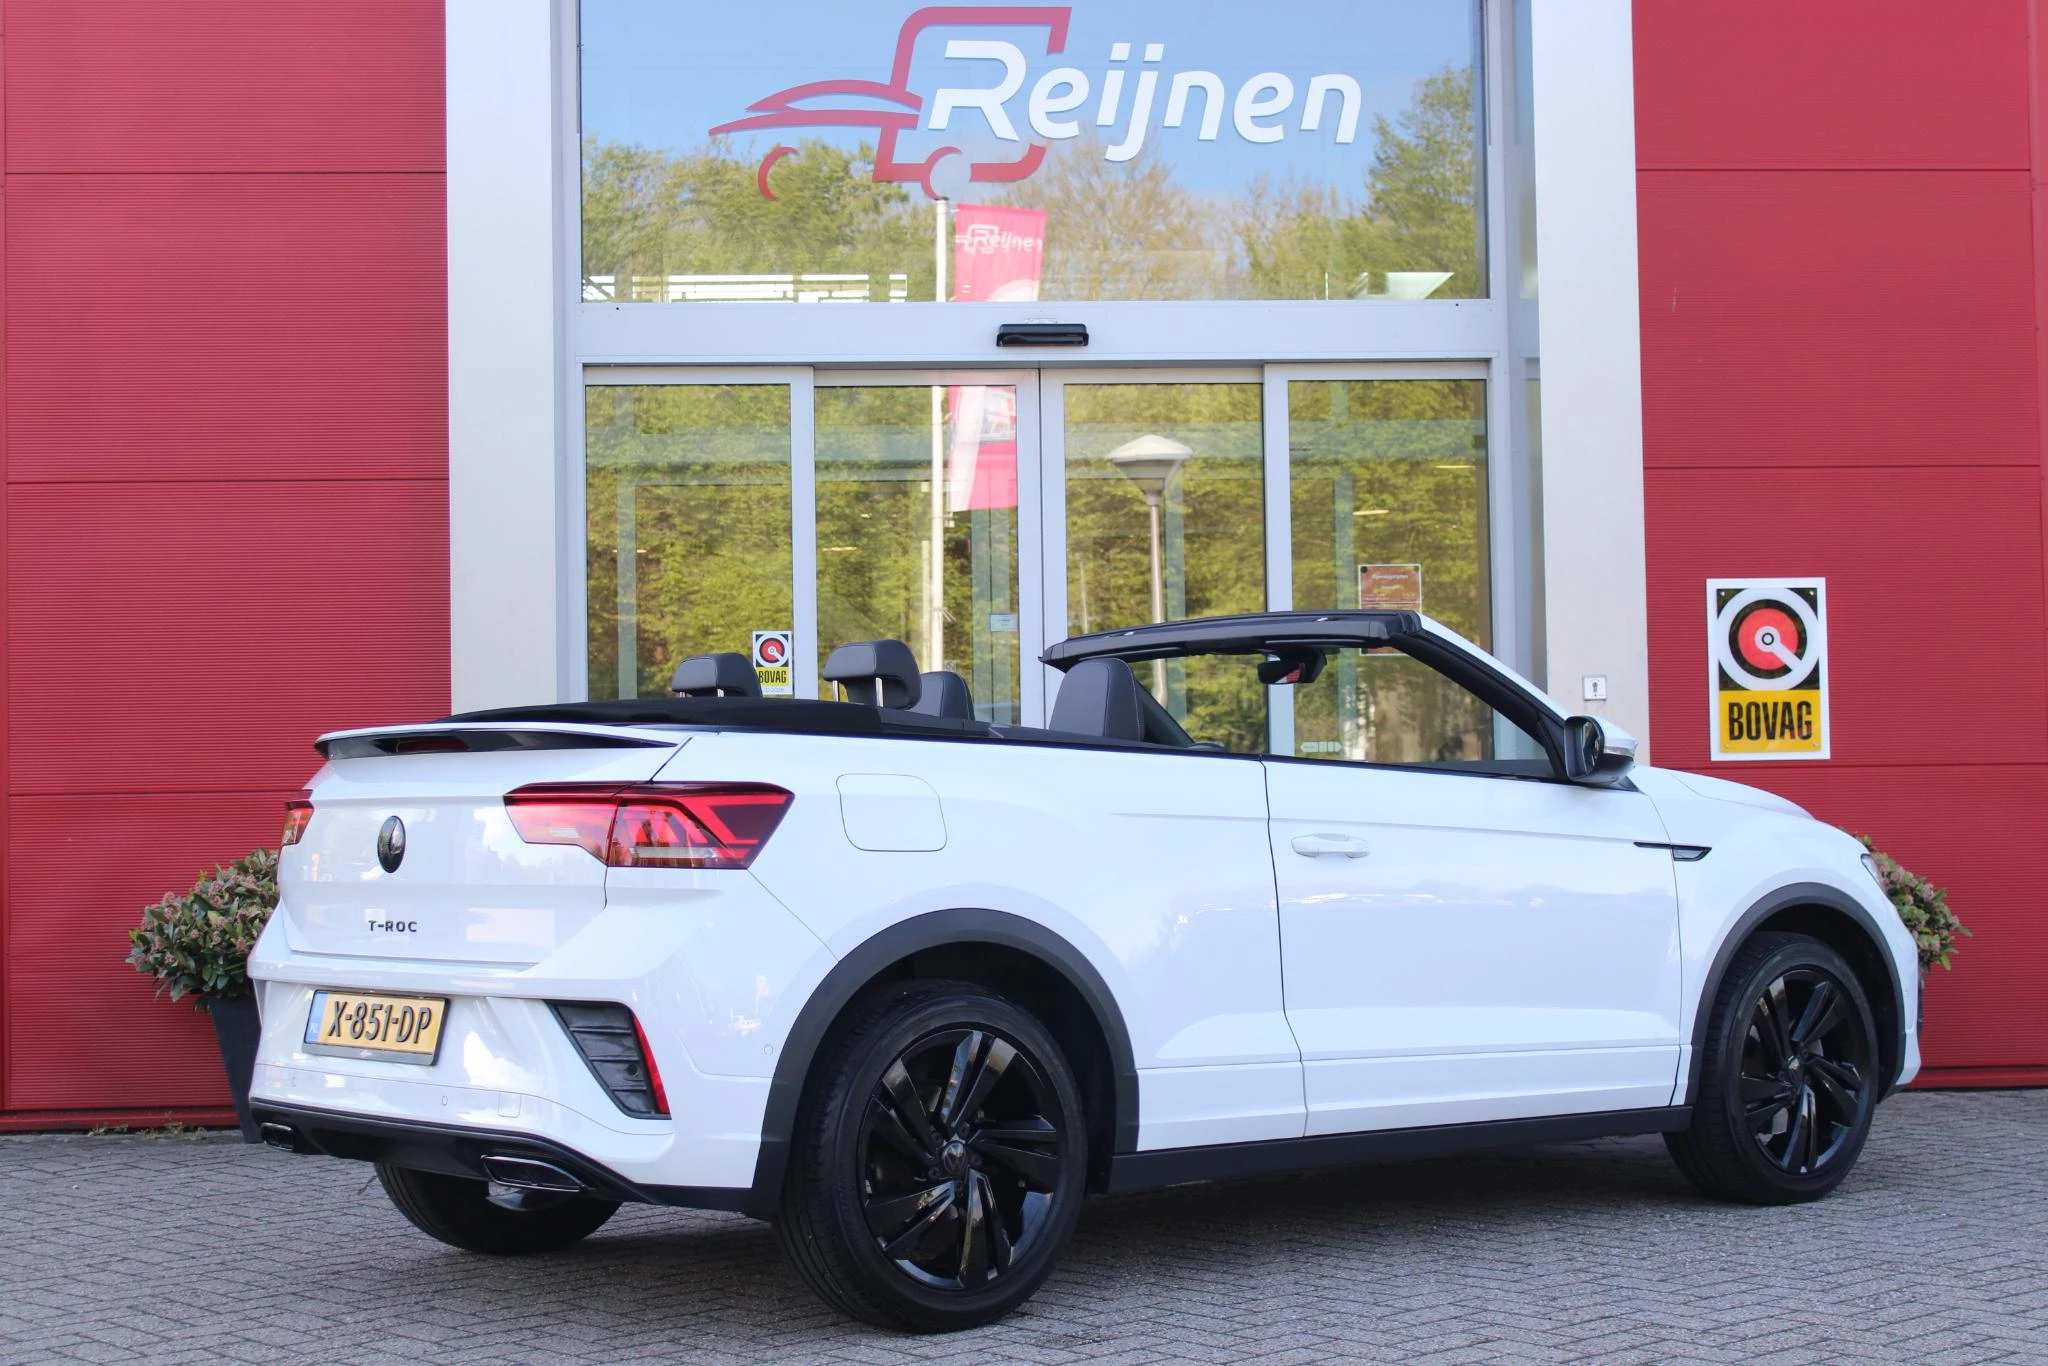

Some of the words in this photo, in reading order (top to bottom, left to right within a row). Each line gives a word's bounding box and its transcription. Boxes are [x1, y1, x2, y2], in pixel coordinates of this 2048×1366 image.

[928, 40, 1361, 162] Reijnen
[758, 670, 787, 684] BOVAG
[1728, 701, 1812, 741] BOVAG
[368, 920, 417, 932] T-ROC
[328, 1000, 432, 1044] X-851-DP
